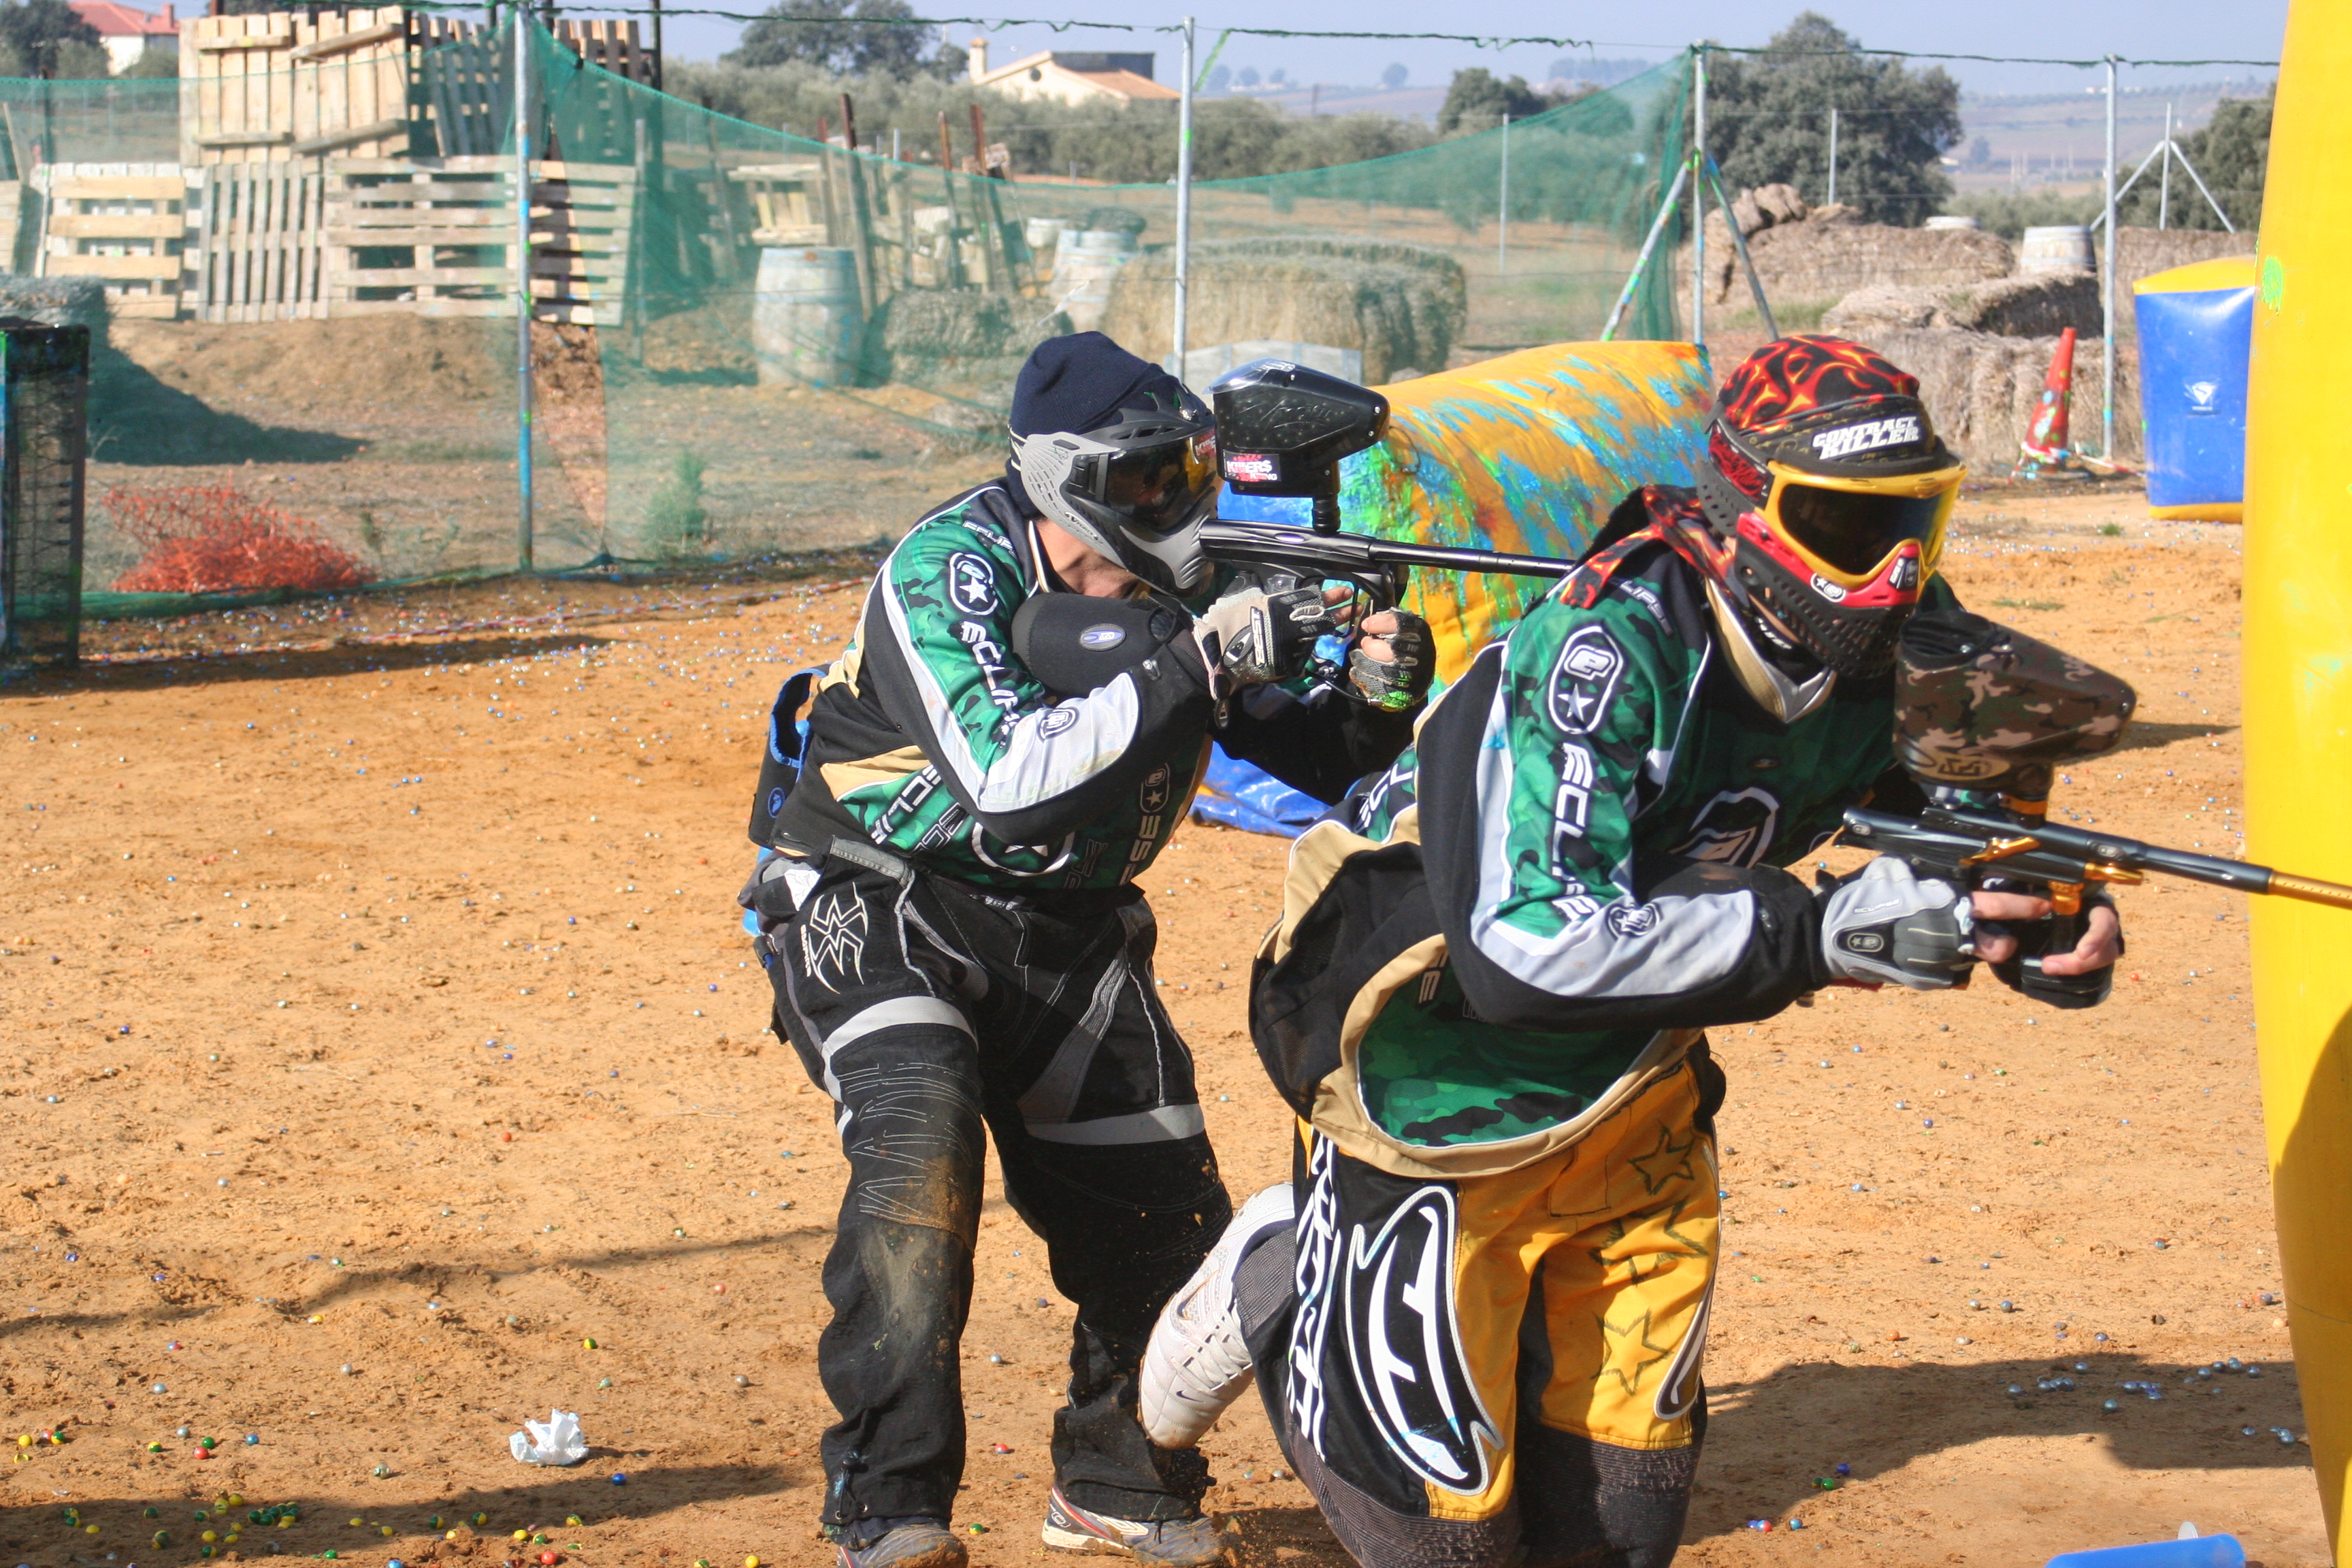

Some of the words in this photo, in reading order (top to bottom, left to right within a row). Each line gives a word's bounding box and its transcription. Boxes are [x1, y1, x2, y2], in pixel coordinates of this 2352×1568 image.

[1812, 416, 1916, 448] CONTRACT
[1818, 426, 1919, 461] KILLER
[1251, 607, 1266, 666] BEST
